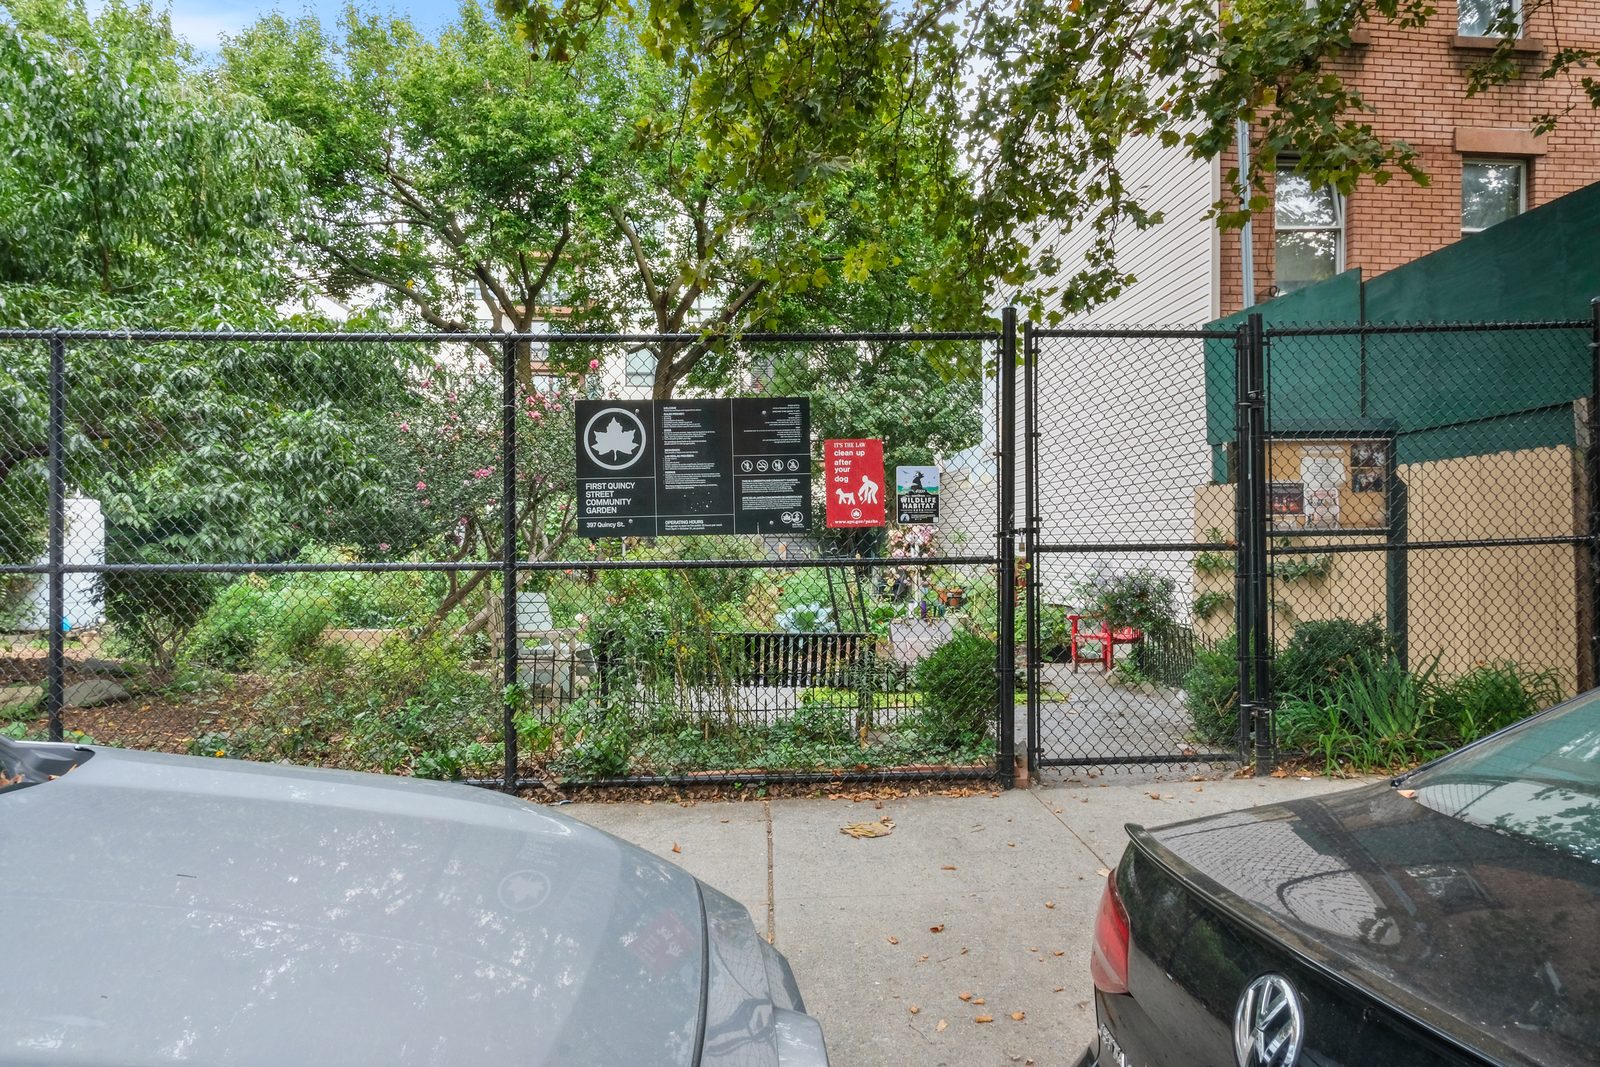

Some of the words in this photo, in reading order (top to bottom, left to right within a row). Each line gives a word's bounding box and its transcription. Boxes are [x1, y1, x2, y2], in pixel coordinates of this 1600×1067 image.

[833, 449, 854, 457] clean
[833, 458, 852, 466] after
[834, 475, 849, 484] dog
[585, 482, 607, 490] FIRST
[607, 481, 636, 490] QUINCY
[585, 490, 615, 498] STREET
[585, 498, 632, 506] COMMUNITY
[585, 506, 617, 514] GARDEN
[597, 521, 617, 529] Quincy
